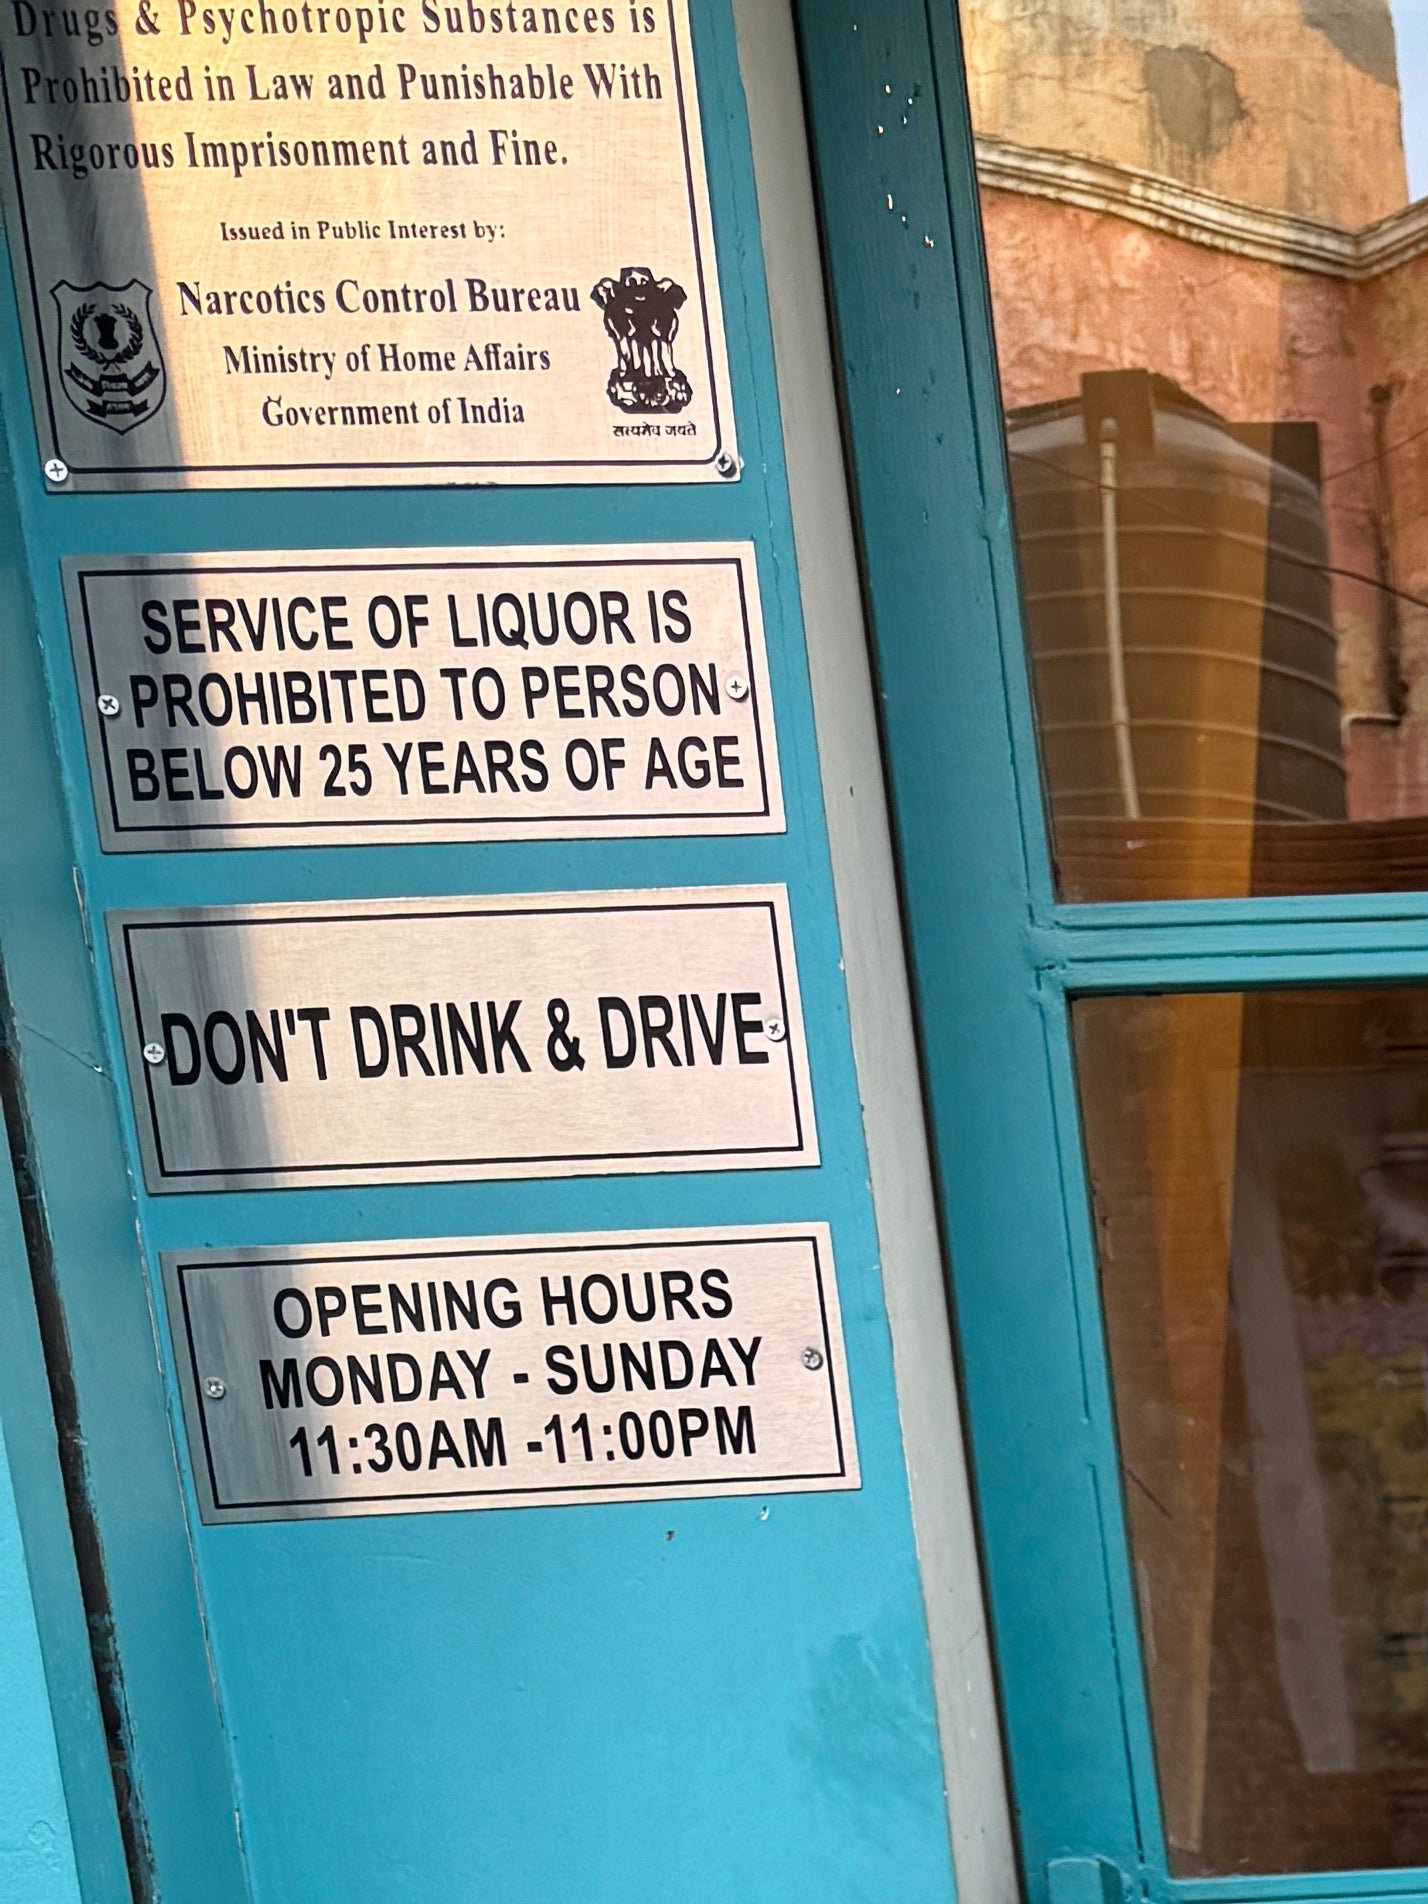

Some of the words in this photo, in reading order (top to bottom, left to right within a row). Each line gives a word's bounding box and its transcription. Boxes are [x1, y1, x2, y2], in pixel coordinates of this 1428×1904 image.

[12, 0, 118, 46] Drugs
[134, 0, 161, 36] &
[177, 0, 407, 44] Psychotropic
[422, 0, 615, 34] Substances
[630, 0, 656, 34] is
[20, 64, 194, 105] Prohibited
[203, 65, 236, 101] in
[245, 64, 314, 101] Law
[328, 64, 386, 100] and
[397, 63, 574, 100] Punishable
[583, 63, 663, 99] With
[30, 134, 175, 179] Rigorous
[184, 130, 410, 178] Imprisonment
[422, 130, 479, 166] and
[489, 129, 568, 165] Fine.
[220, 221, 284, 241] Issued
[292, 221, 311, 240] in
[317, 220, 381, 239] Public
[388, 220, 467, 239] Interest
[474, 220, 505, 243] by:
[177, 280, 326, 316] Narcotics
[336, 278, 457, 313] Control
[465, 278, 581, 312] Bureau
[223, 343, 336, 380] Ministry
[346, 344, 371, 372] of
[379, 344, 456, 372] Home
[464, 343, 551, 371] Affairs
[262, 395, 419, 427] Government
[428, 397, 451, 424] of
[459, 397, 524, 423] India
[142, 596, 353, 654] SERVICE
[367, 594, 429, 648] OF
[447, 591, 632, 652] LIQUOR
[649, 590, 692, 643] IS
[130, 668, 426, 727] PROHIBITED
[440, 666, 506, 722] TO
[524, 664, 722, 718] PERSON
[128, 744, 302, 801] BELOW
[318, 743, 372, 797] 25
[382, 738, 549, 795] YEARS
[565, 737, 626, 790] OF
[645, 735, 745, 789] AGE
[162, 1007, 332, 1087] DON'T
[352, 1000, 531, 1080] DRINK
[547, 998, 586, 1072] &
[604, 992, 771, 1070] DRIVE
[273, 1277, 523, 1339] OPENING
[541, 1268, 733, 1327] HOURS
[259, 1349, 493, 1410] MONDAY
[546, 1337, 763, 1394] SUNDAY
[289, 1417, 508, 1477] 11:30AM
